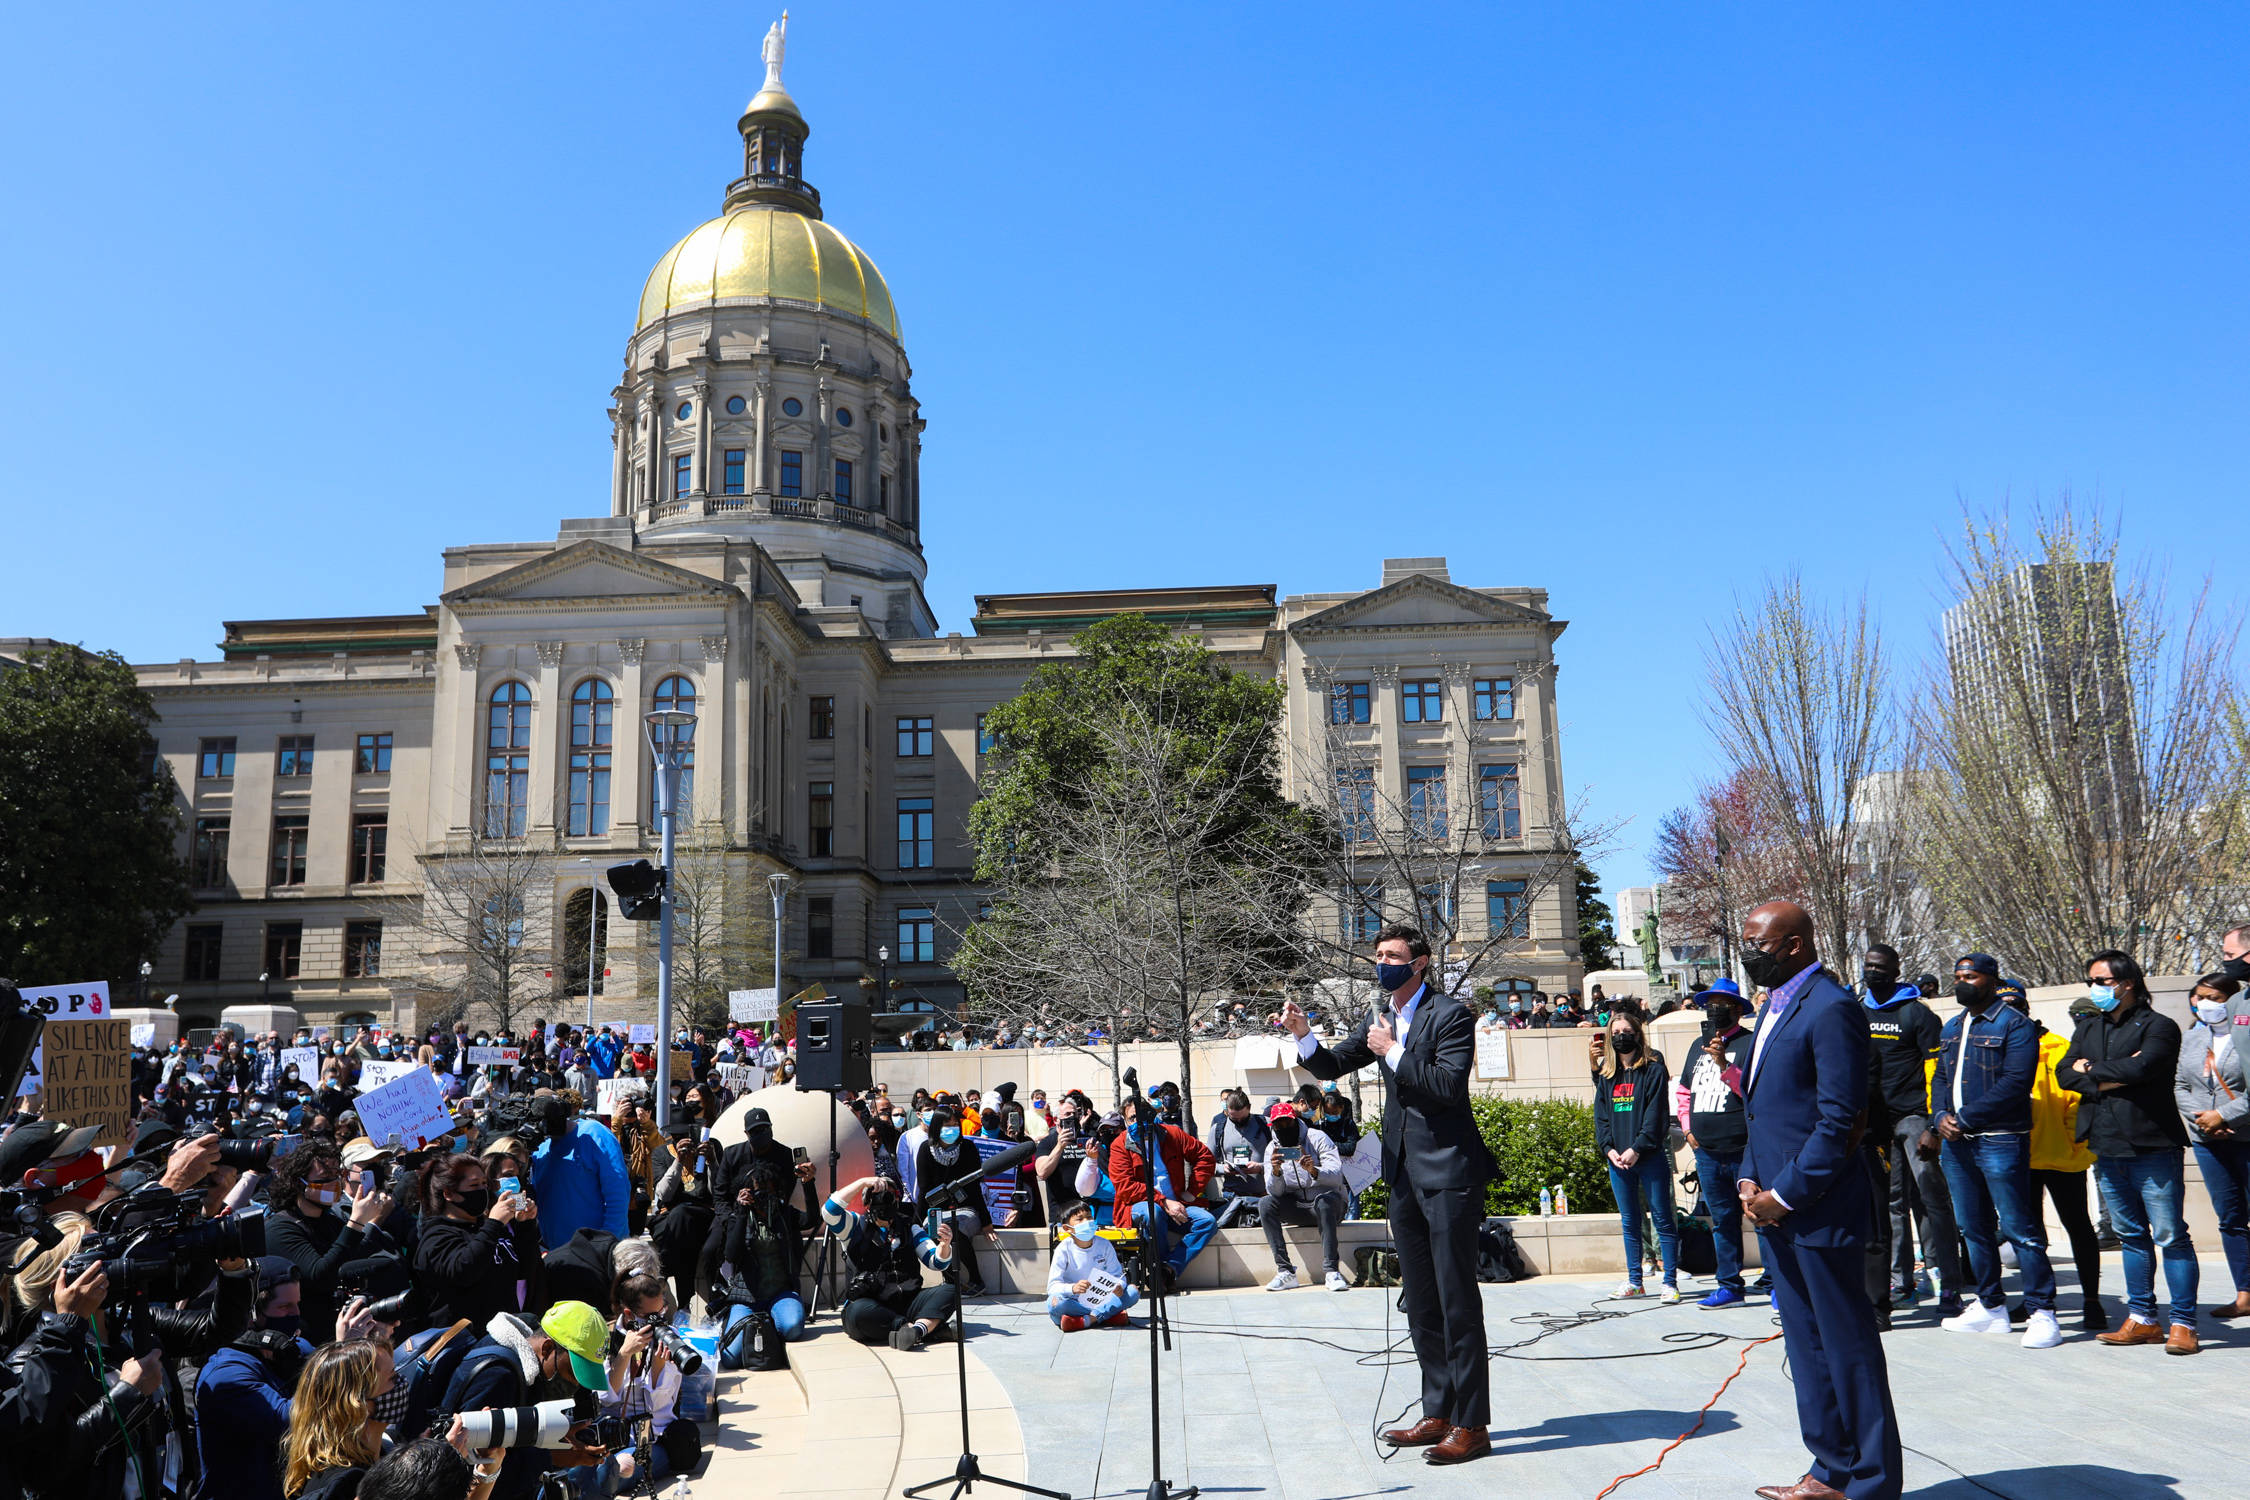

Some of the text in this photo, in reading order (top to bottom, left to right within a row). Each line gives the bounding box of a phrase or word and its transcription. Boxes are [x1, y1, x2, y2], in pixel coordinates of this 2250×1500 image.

[50, 1022, 128, 1051] SILENCE
[1870, 1022, 1902, 1032] OUGH.
[48, 1055, 69, 1083] AT
[75, 1056, 88, 1081] A
[92, 1053, 127, 1079] TIME
[47, 1084, 127, 1113] LIKE THIS IS
[195, 1098, 239, 1112] STP
[360, 1096, 382, 1113] We
[385, 1081, 408, 1099] had
[1693, 1091, 1727, 1113] HATE
